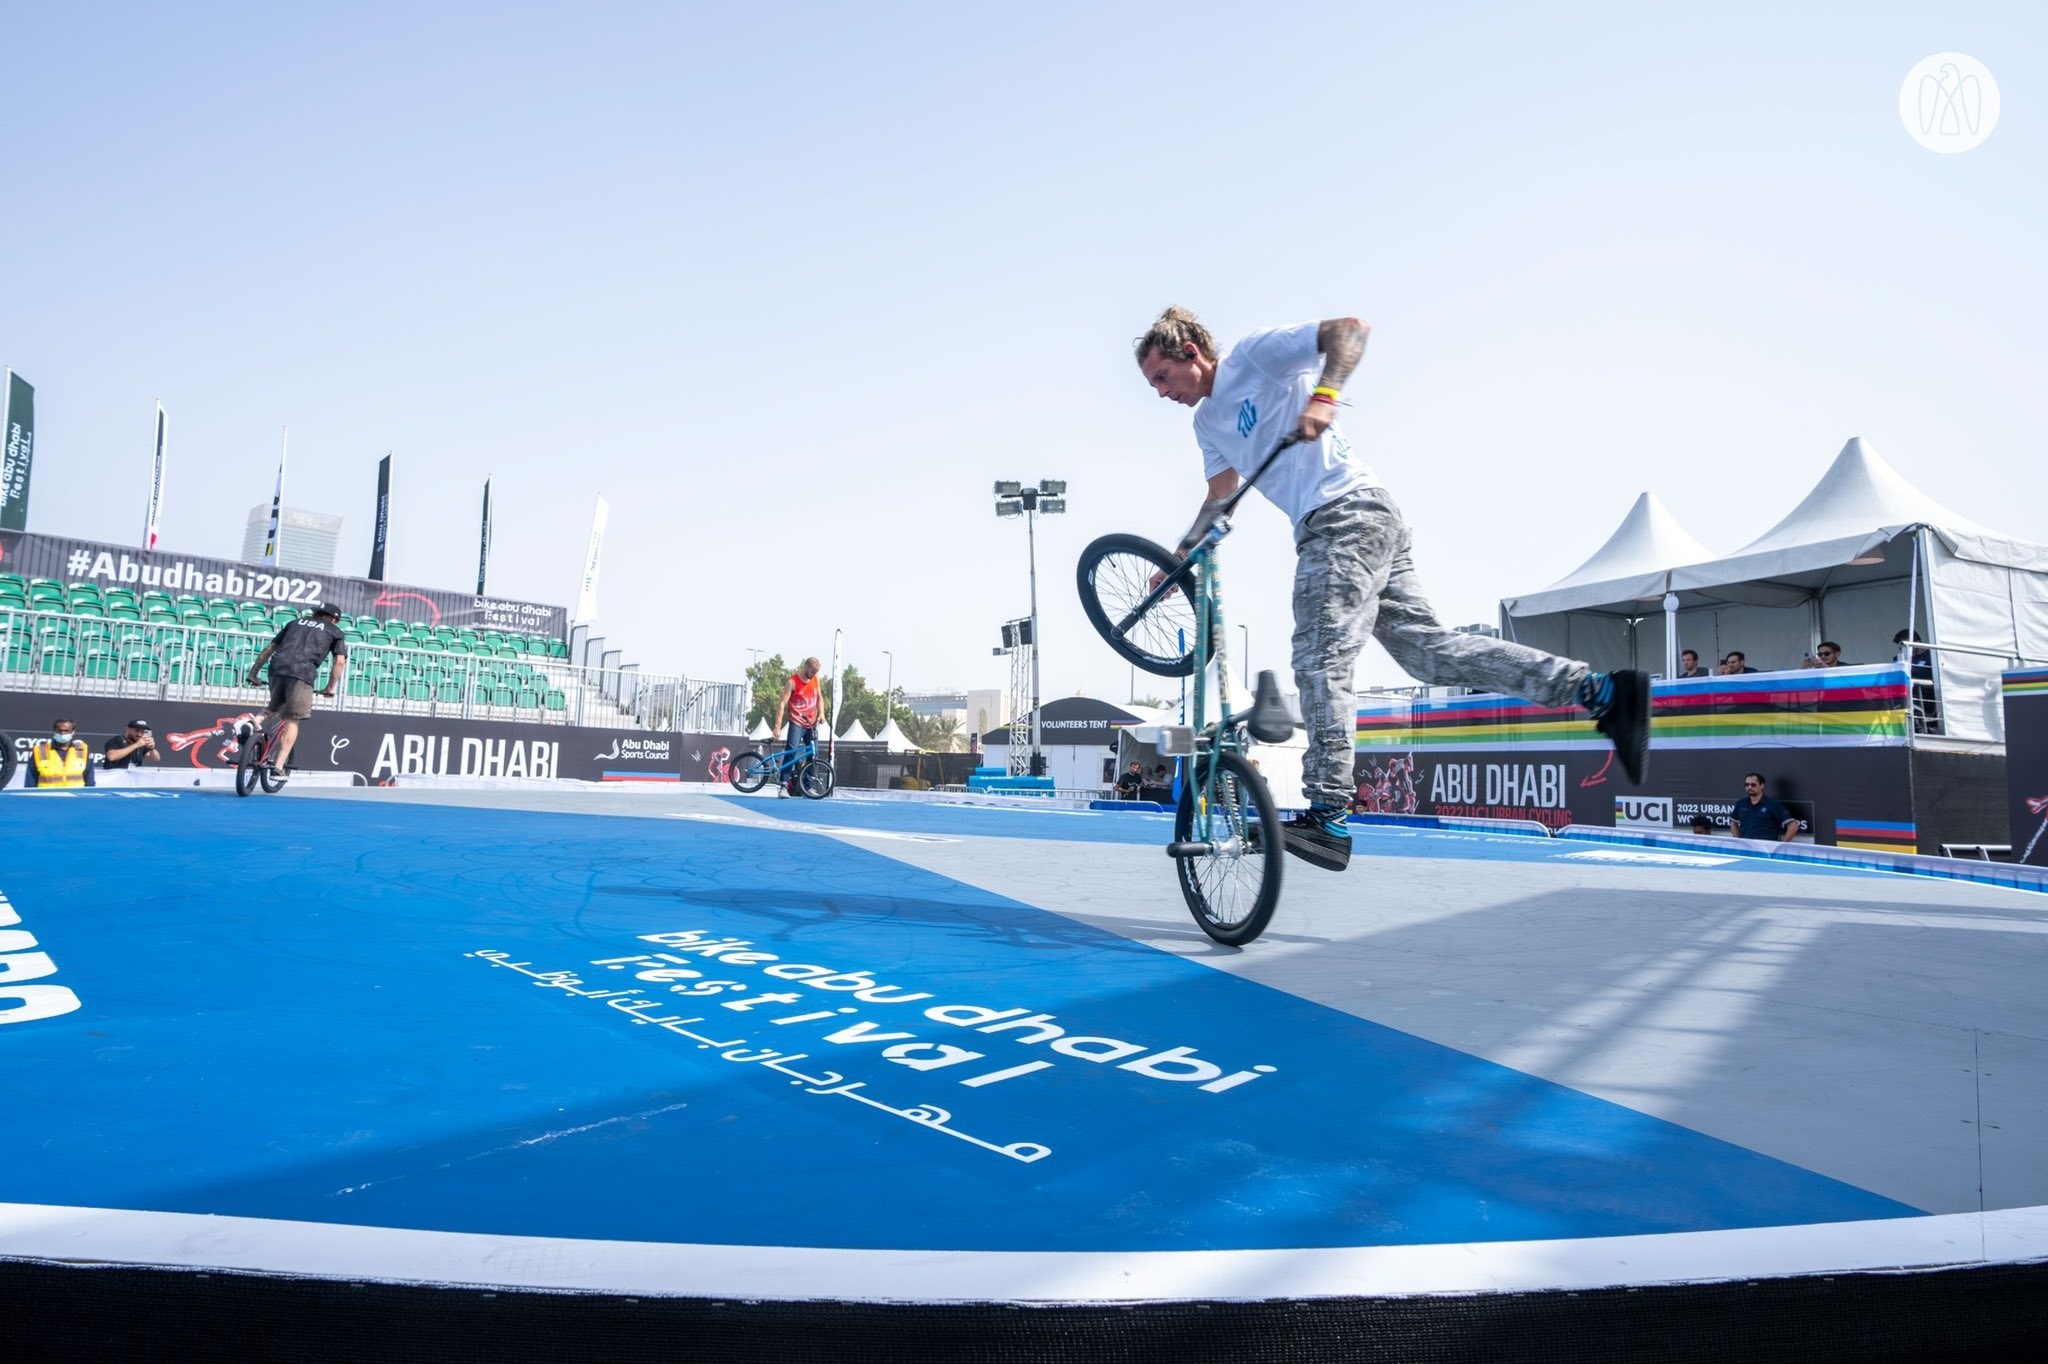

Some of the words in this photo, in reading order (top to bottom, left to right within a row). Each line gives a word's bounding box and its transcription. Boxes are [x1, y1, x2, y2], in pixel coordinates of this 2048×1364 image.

[7, 422, 22, 458] dhabi
[3, 459, 16, 482] abu
[67, 549, 322, 606] #Abudhabi2022
[473, 598, 498, 610] bike
[498, 601, 519, 612] abu
[521, 604, 552, 617] dhabi
[298, 619, 325, 631] USA
[1041, 720, 1088, 729] VOLUNTEERS
[1089, 720, 1108, 728] TENT
[621, 739, 641, 750] Abu
[643, 740, 670, 751] Dhabi
[621, 750, 644, 760] Sports
[644, 750, 670, 760] Council
[371, 733, 450, 779] ABU
[459, 737, 560, 779] DHABI
[1430, 763, 1477, 804] ABU
[1486, 764, 1566, 808] DHABI
[1435, 804, 1464, 817] 2022
[1492, 807, 1526, 819] URBAN
[1529, 809, 1572, 826] CYCLING
[1625, 802, 1668, 822] UCI
[1677, 803, 1698, 813] 2022
[1700, 804, 1735, 814] URBAN
[636, 930, 779, 965] bike
[763, 964, 935, 1003] abu
[924, 1005, 1278, 1093] dhabi
